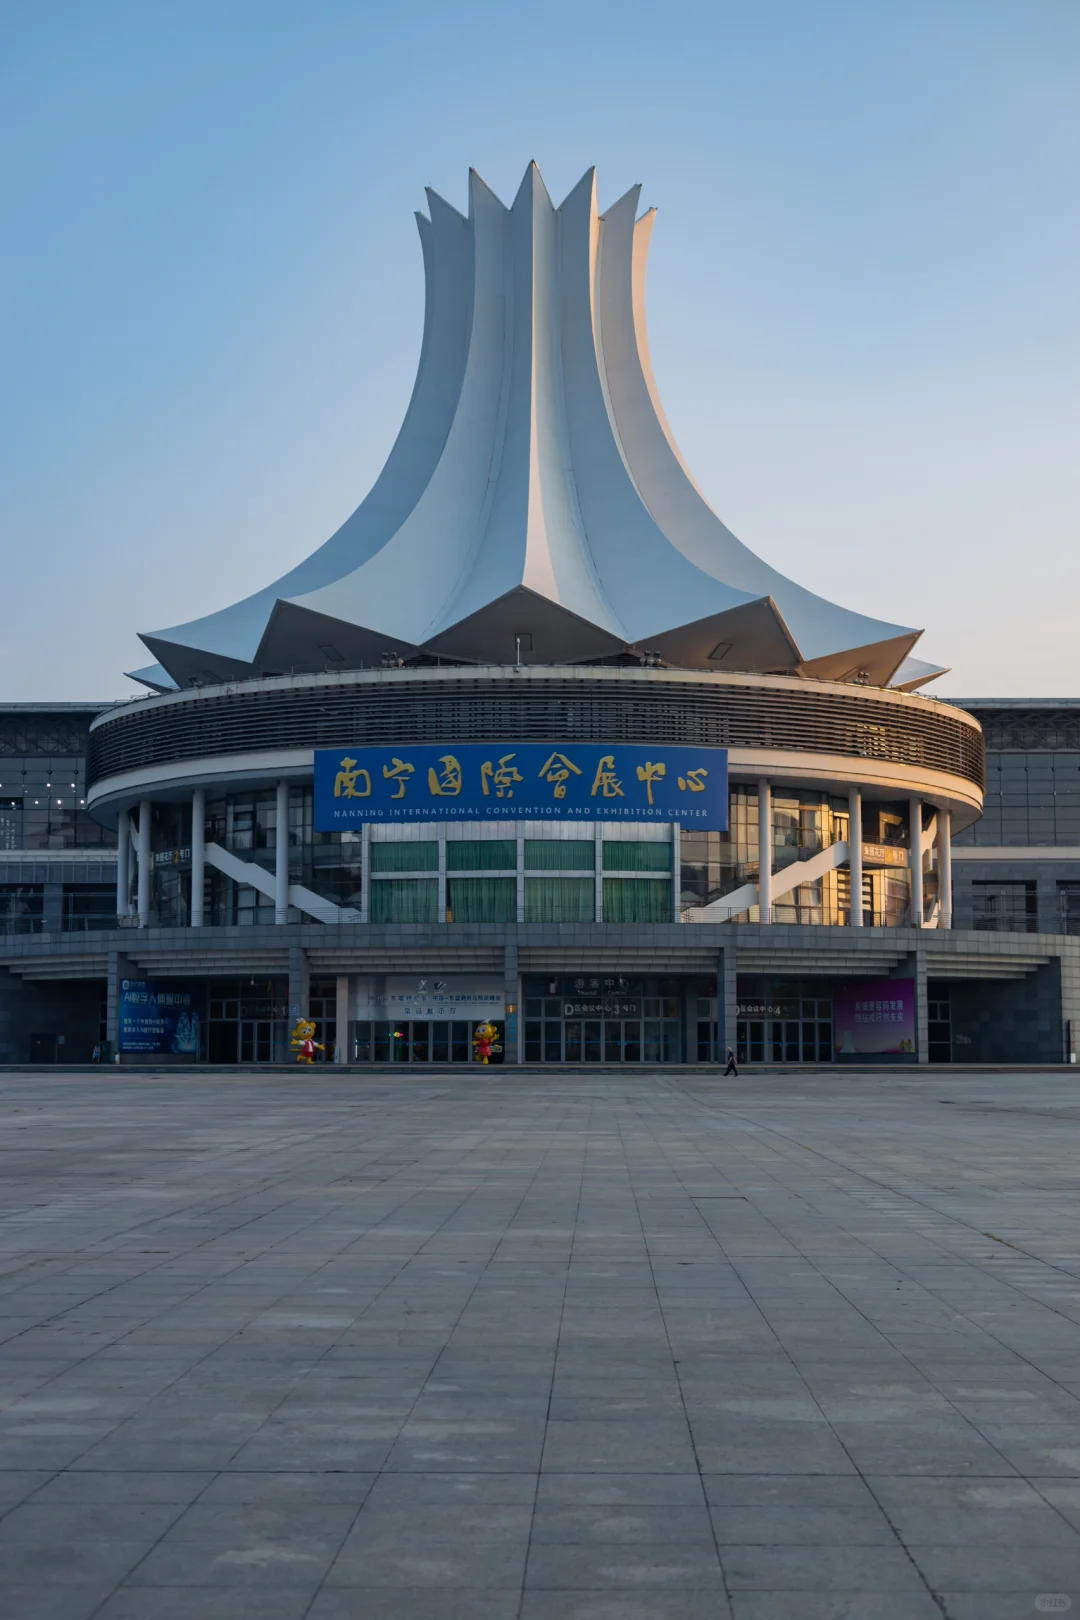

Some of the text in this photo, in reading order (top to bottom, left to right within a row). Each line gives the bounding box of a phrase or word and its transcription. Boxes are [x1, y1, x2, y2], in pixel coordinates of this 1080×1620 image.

[334, 806, 708, 818] NANNING INTERNATIONAL CONVENTION AND EXHIBITION CENTER
